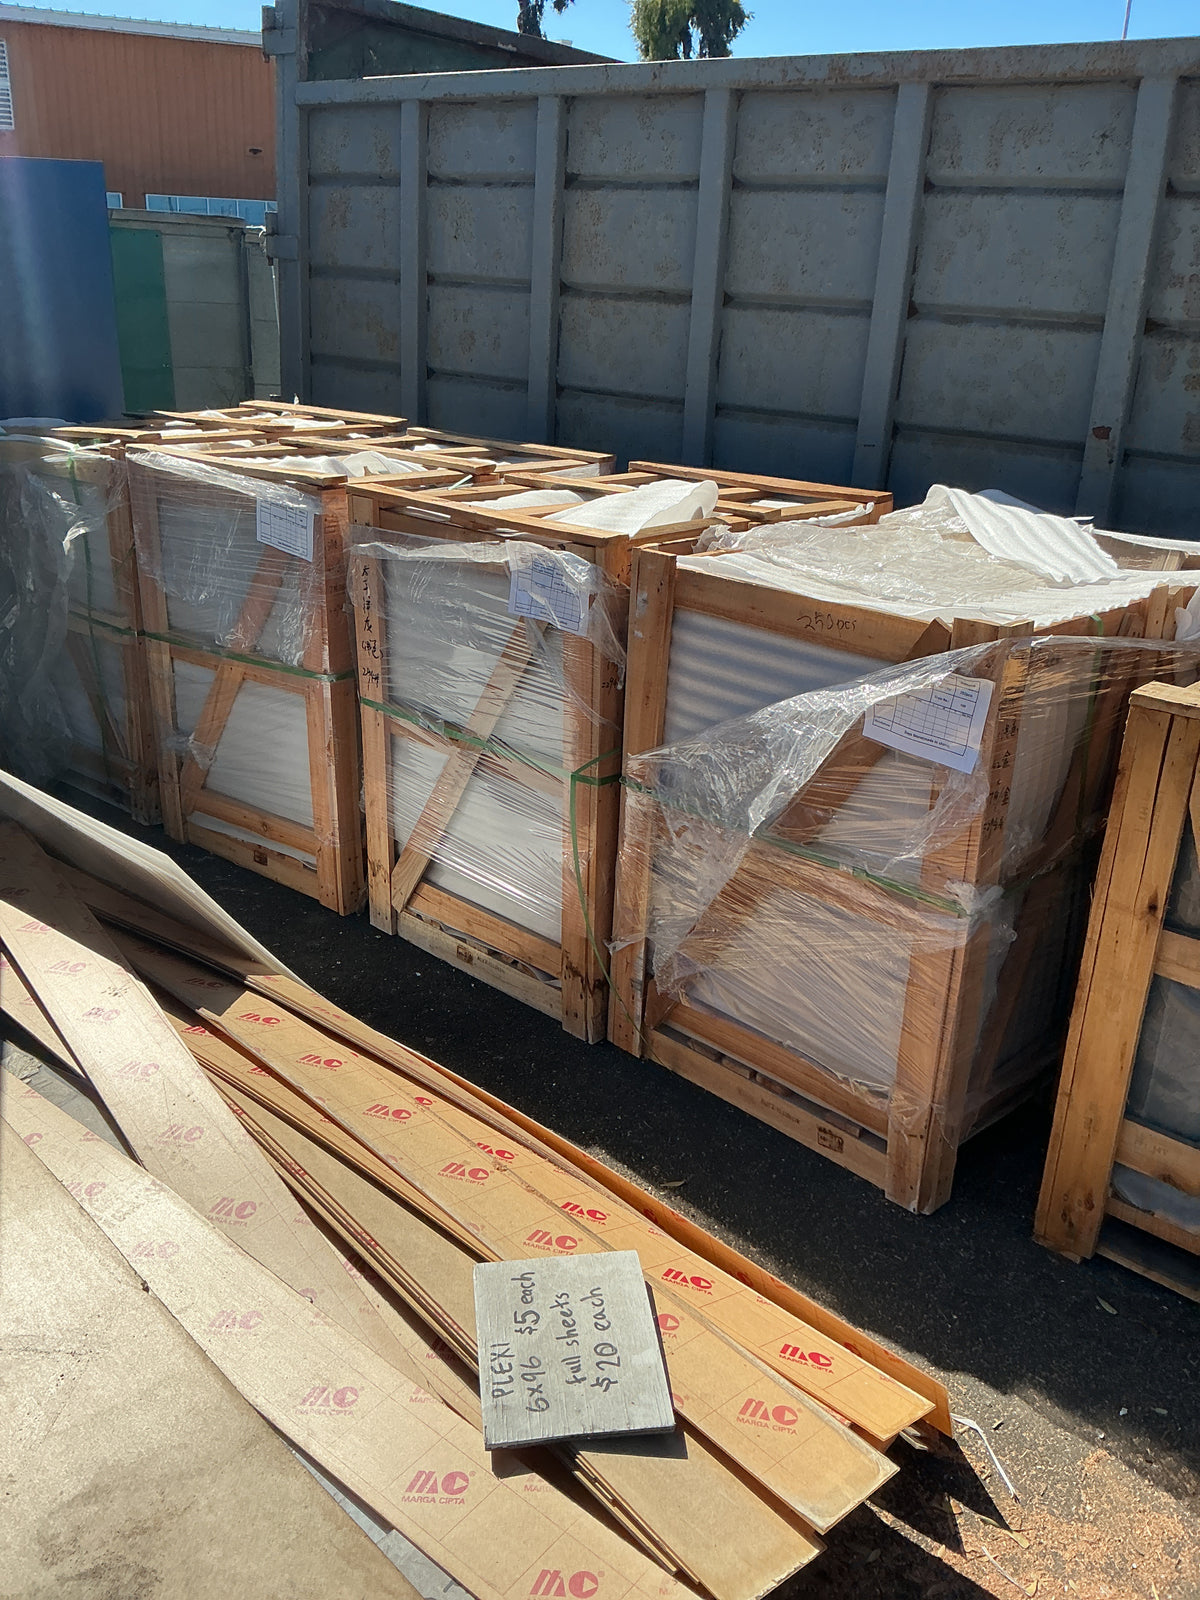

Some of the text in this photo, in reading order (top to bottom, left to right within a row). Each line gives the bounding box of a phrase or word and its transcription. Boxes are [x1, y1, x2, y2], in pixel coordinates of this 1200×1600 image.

[523, 1241, 551, 1251] MARGA
[511, 1271, 536, 1305] each
[661, 1276, 713, 1296] MARGA CIPTA
[580, 1287, 611, 1332] each
[513, 1310, 541, 1335] $5
[550, 1292, 587, 1387] full sheets
[490, 1342, 516, 1399] PLEXI
[779, 1354, 834, 1374] MARGA CIPTA
[736, 1416, 798, 1436] MARGA CIPTA
[401, 1495, 466, 1506] MARGA CIPTA
